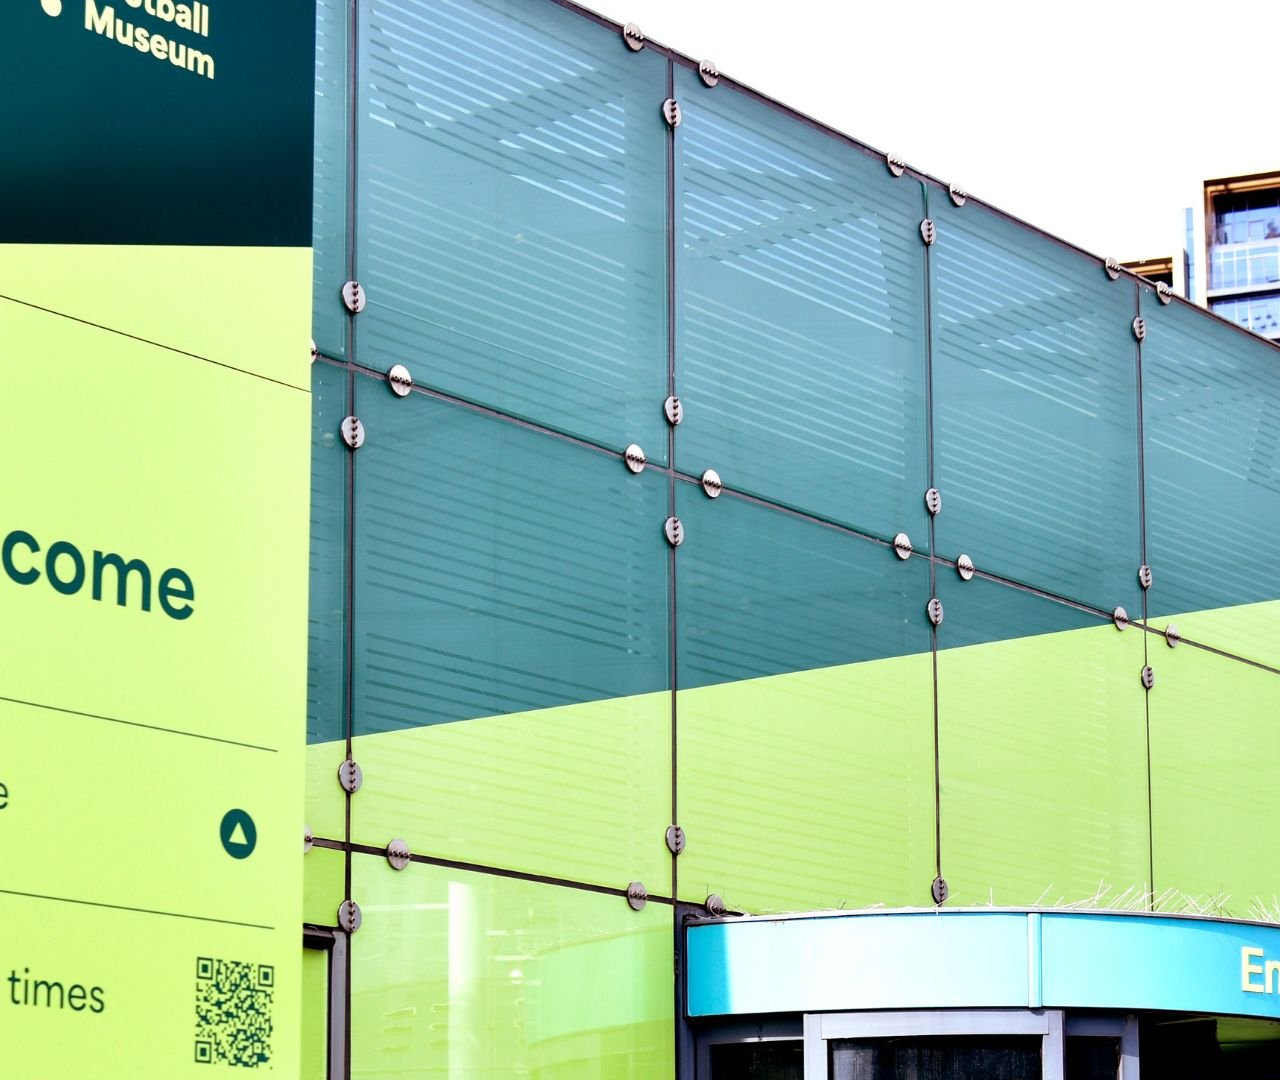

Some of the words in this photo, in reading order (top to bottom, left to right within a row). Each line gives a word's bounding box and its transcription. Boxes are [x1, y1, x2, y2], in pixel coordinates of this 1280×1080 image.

[84, 0, 215, 80] Museum
[125, 0, 209, 37] tball
[8, 966, 106, 1014] times
